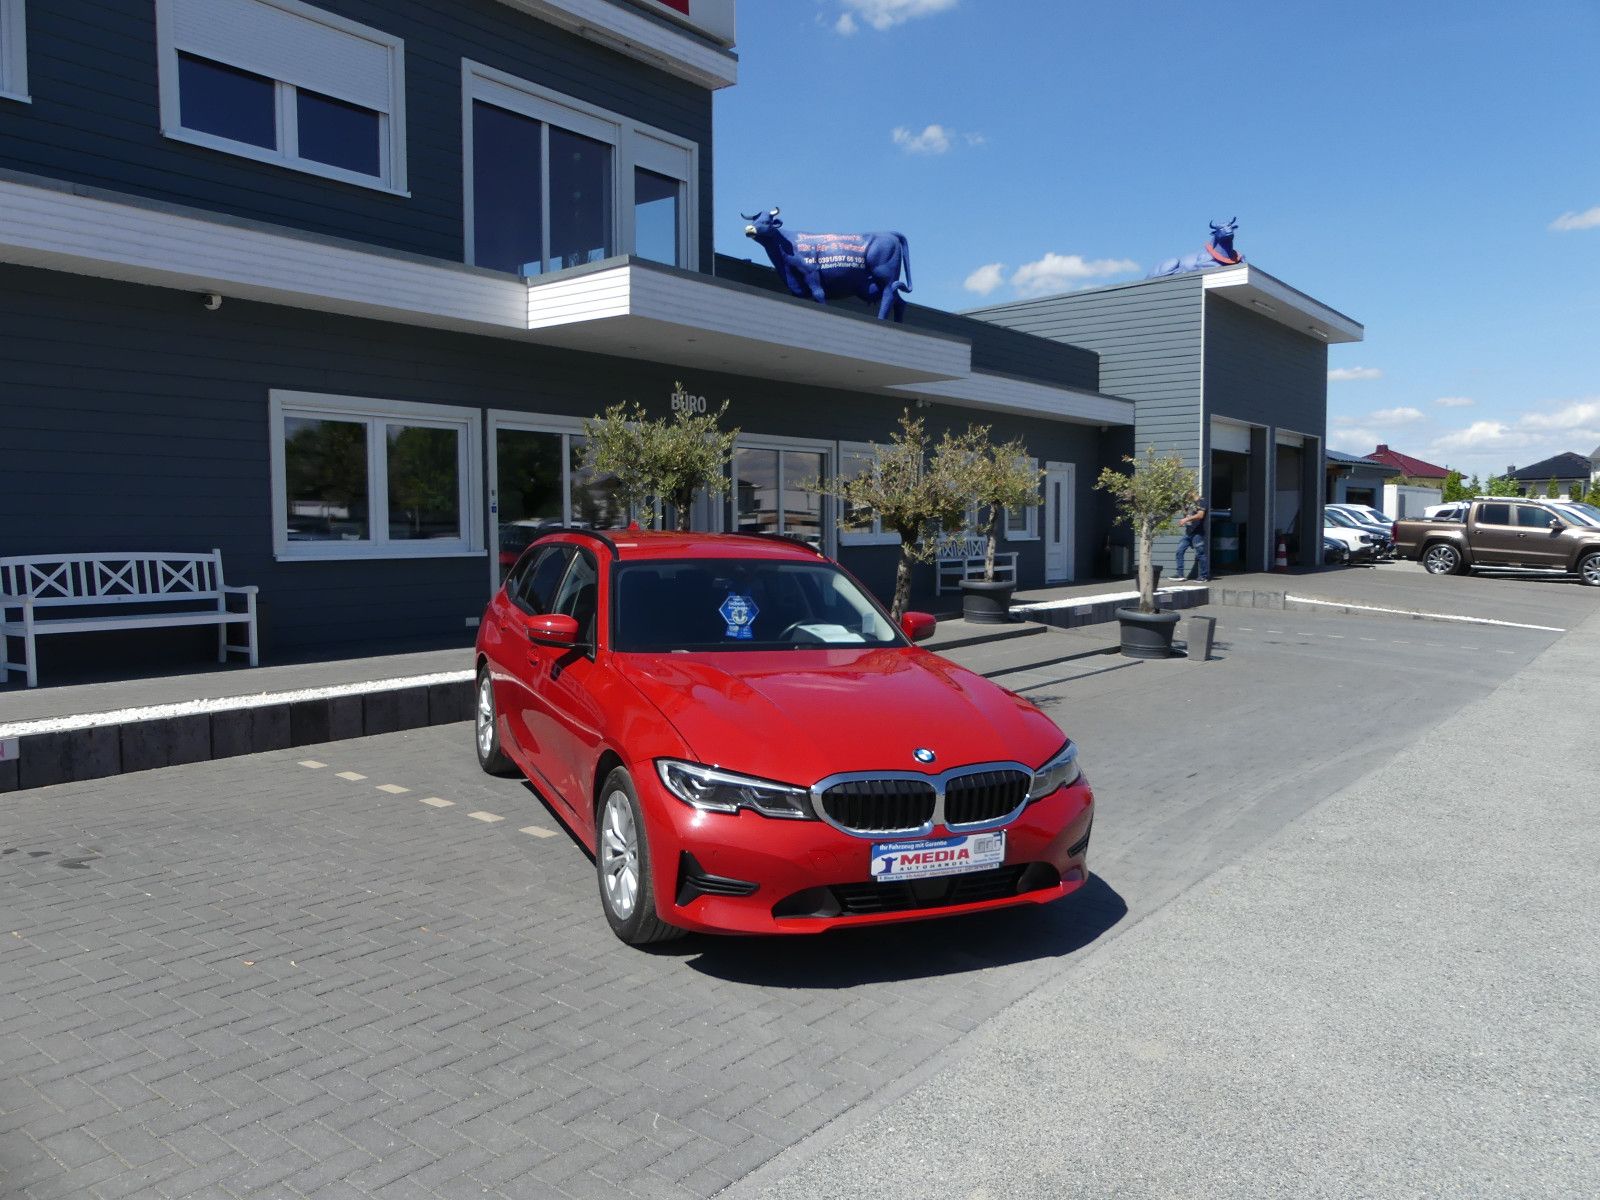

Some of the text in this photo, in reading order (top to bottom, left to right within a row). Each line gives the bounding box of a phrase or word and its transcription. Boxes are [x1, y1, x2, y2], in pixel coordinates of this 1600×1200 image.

[671, 391, 707, 413] BÜRO
[879, 843, 888, 851] Ihr
[888, 843, 914, 851] Fahrzeug
[925, 840, 948, 848] Garantie
[900, 848, 970, 866] MEDIA
[900, 860, 970, 871] AUTOHANDEL
